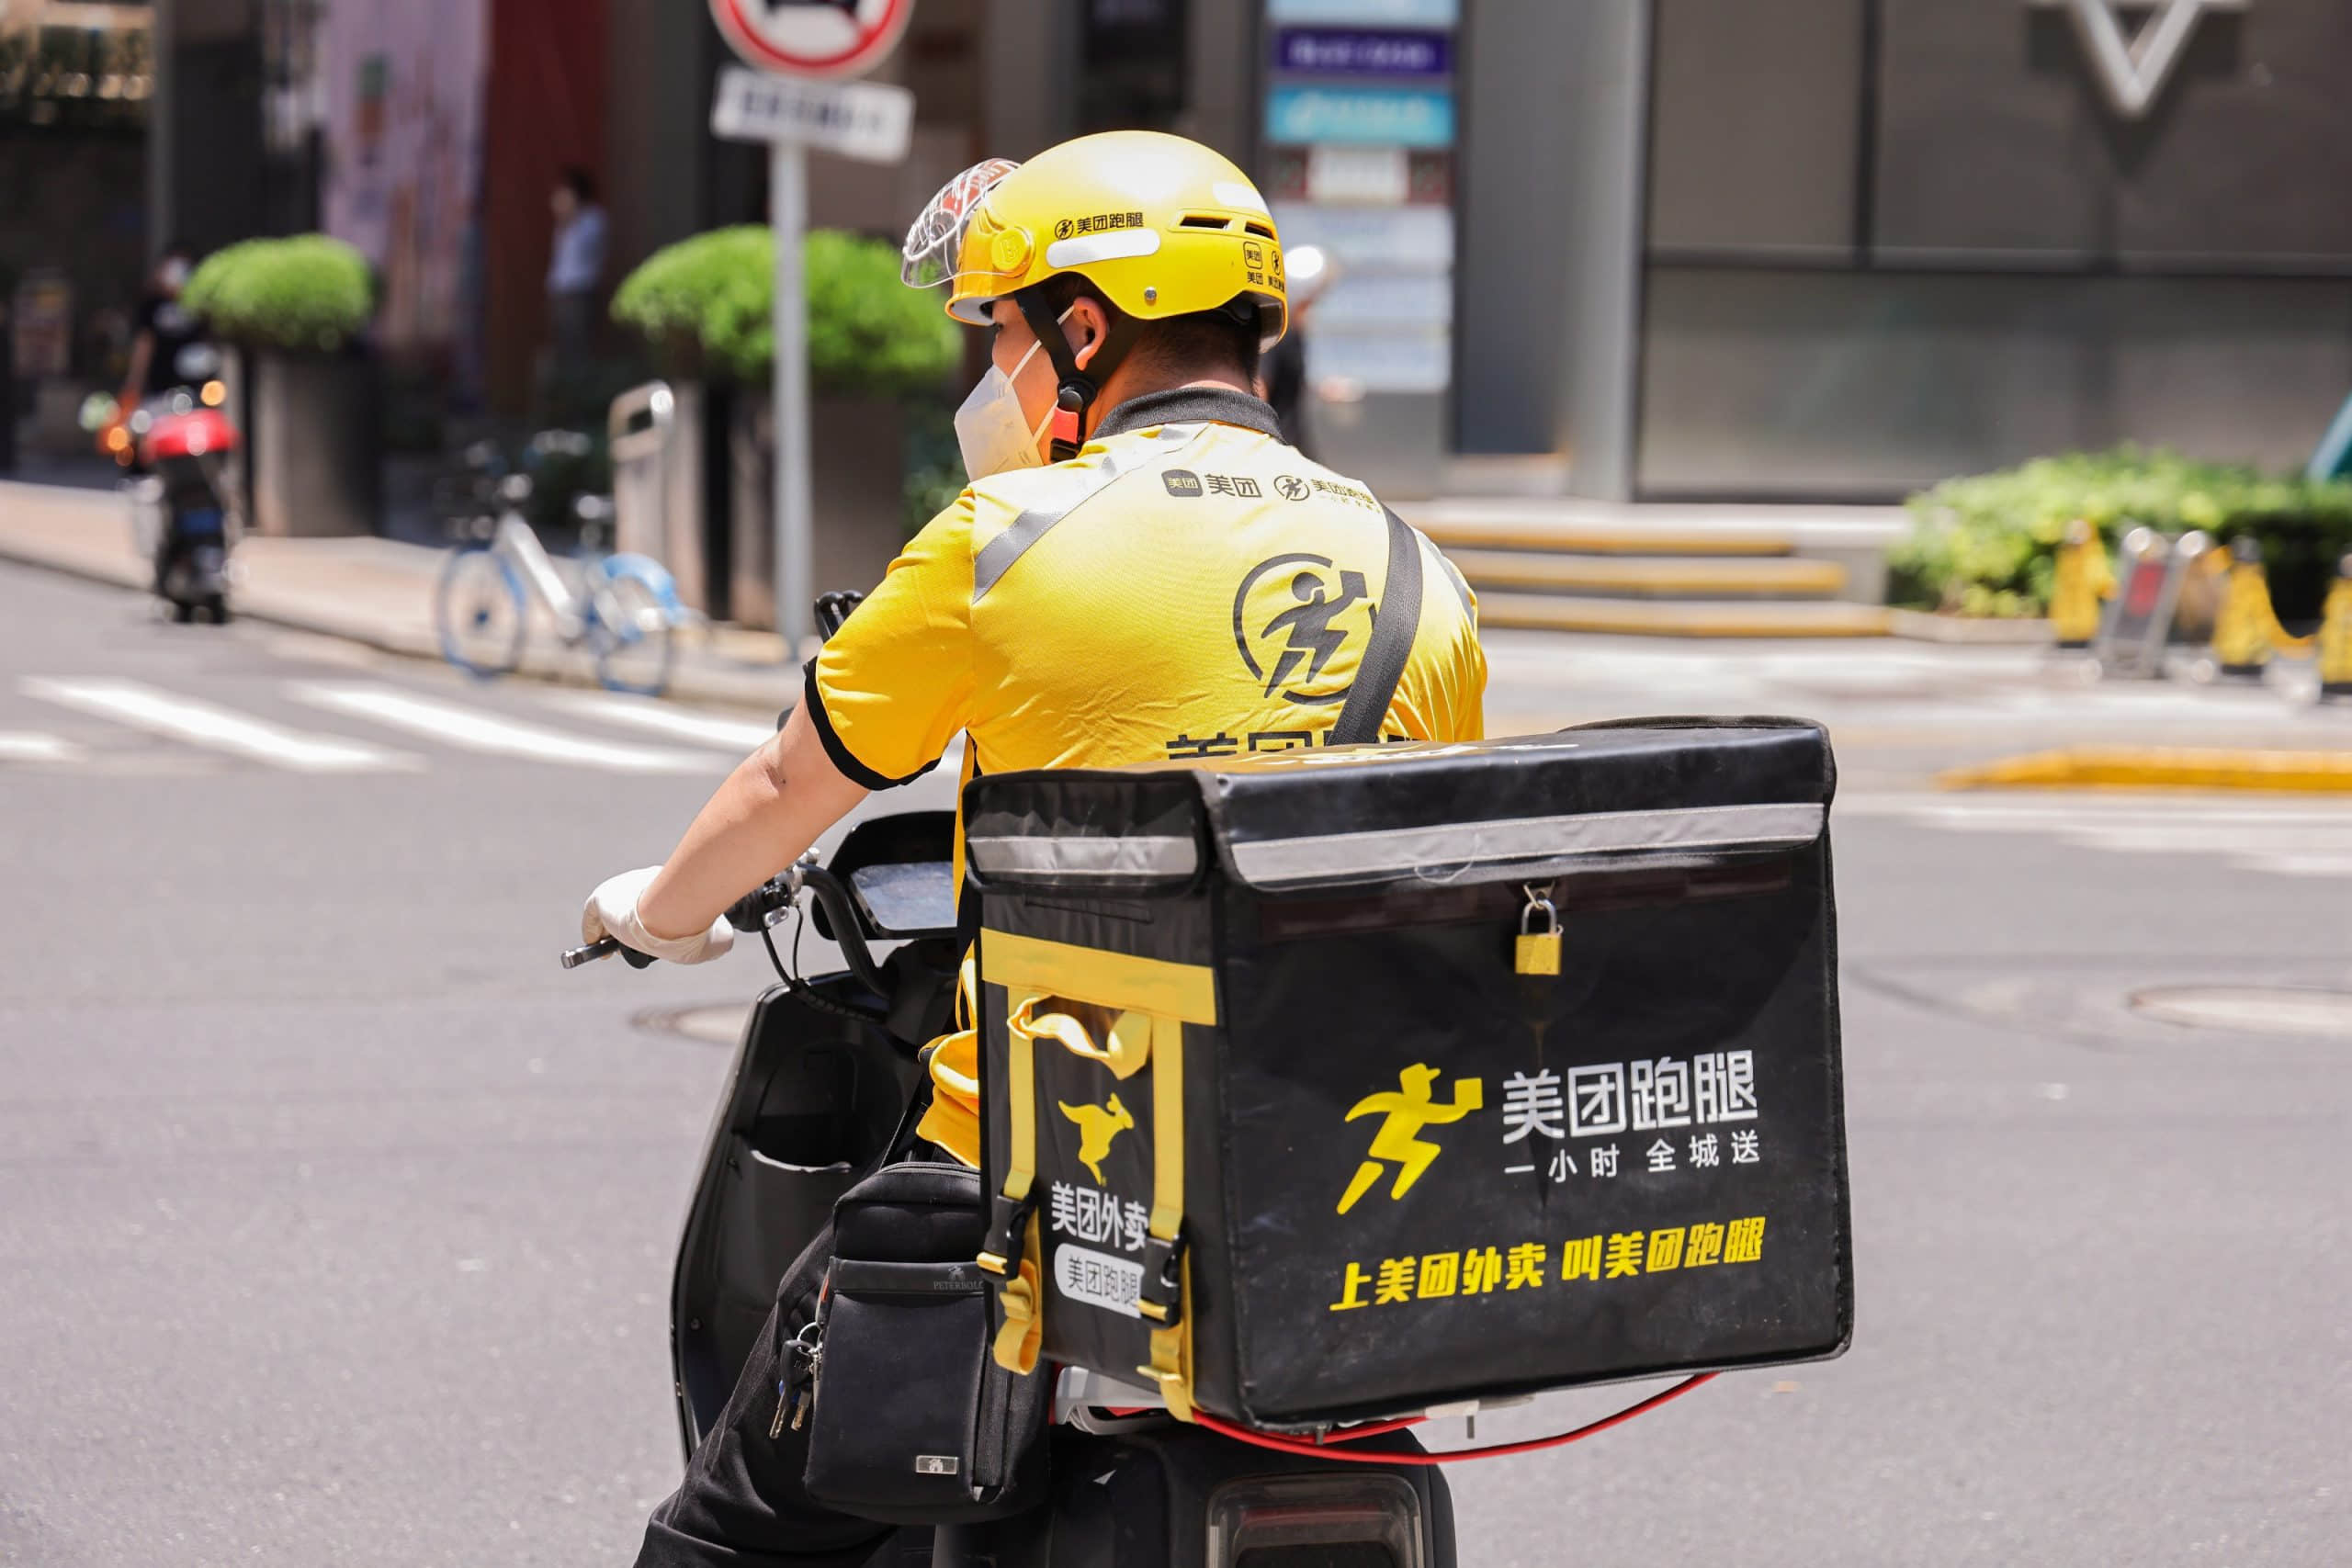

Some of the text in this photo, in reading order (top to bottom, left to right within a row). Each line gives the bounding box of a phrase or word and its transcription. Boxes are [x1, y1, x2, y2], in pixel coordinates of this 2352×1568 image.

[1077, 212, 1144, 233] 美团跑腿
[1167, 477, 1199, 490] 美团
[1204, 473, 1262, 498] 美团
[1502, 1049, 1758, 1145] 美团跑腿
[1504, 1130, 1760, 1184] 一小时 全城送
[1051, 1180, 1149, 1252] 美团外卖
[1068, 1257, 1140, 1308] 美团跑腿
[1329, 1216, 1767, 1311] 上美团外卖 叫美团跑腿
